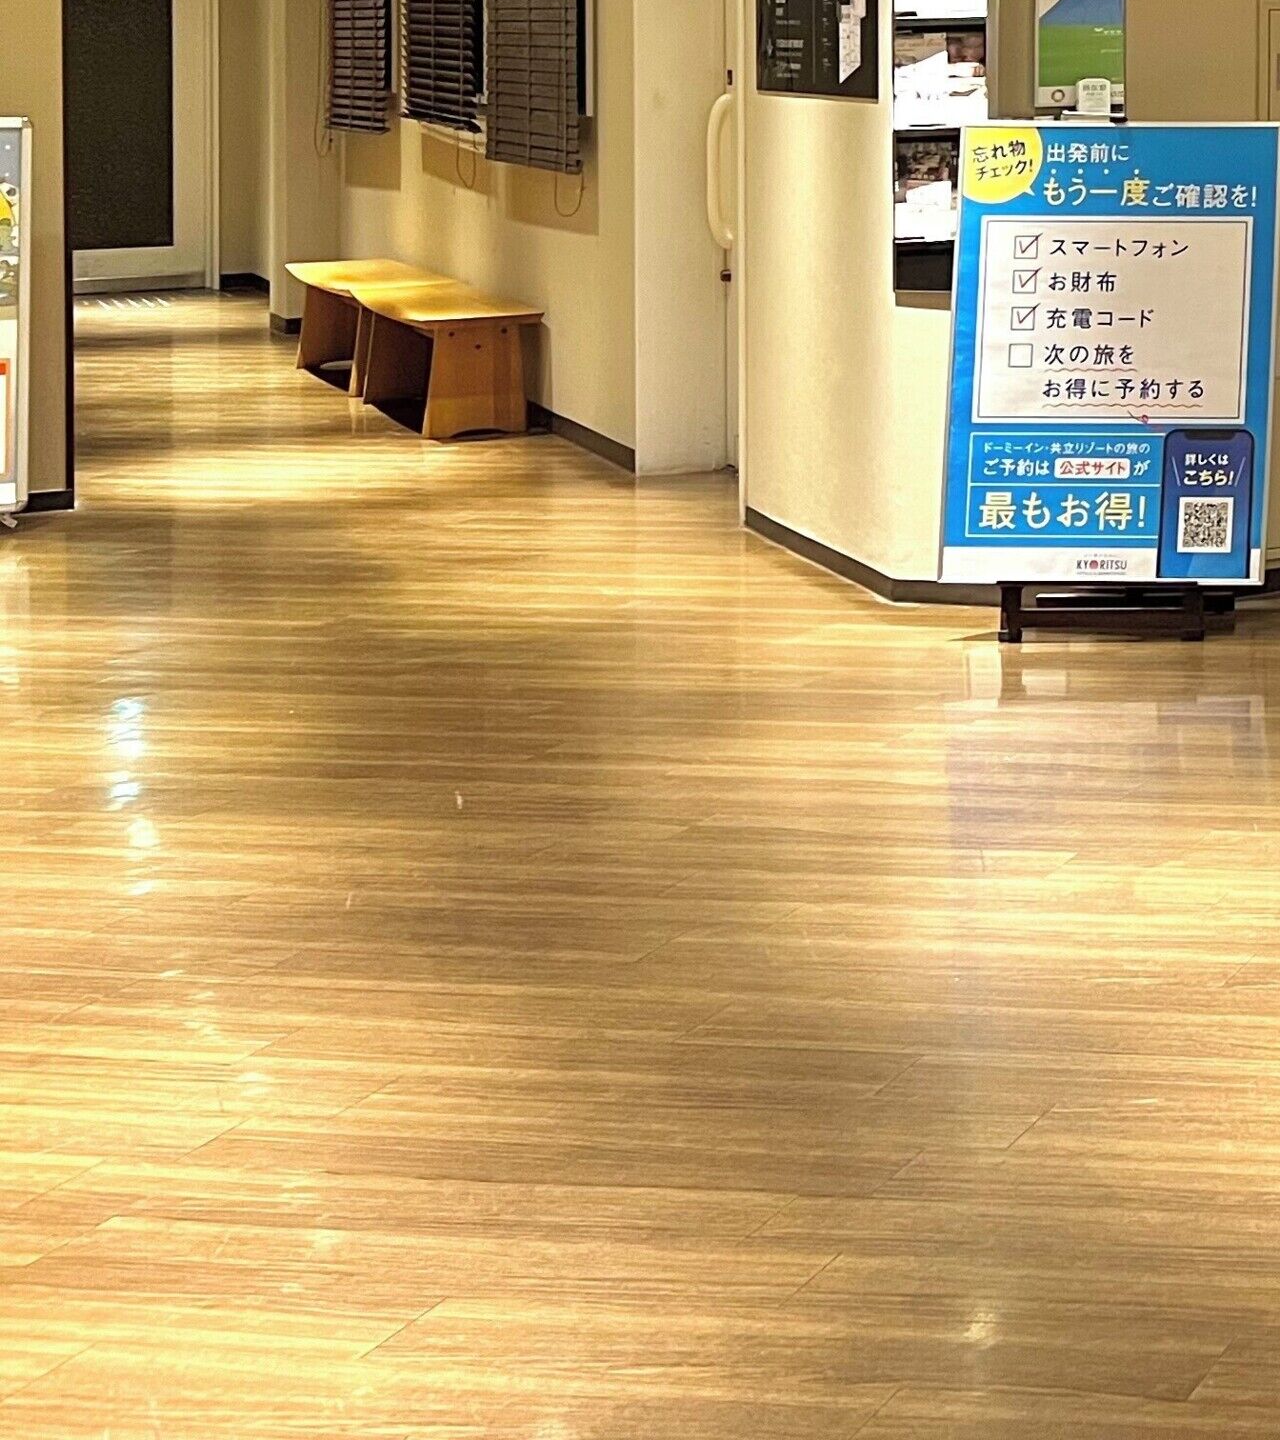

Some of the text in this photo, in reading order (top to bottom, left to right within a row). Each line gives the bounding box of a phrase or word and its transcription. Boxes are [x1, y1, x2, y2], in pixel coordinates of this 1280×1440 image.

[972, 140, 1026, 163] 忘れ物
[1046, 143, 1130, 163] 出発前に
[975, 159, 1034, 182] チェック!
[1050, 238, 1189, 258] スマートフォン
[1048, 271, 1117, 293] お財布
[1046, 307, 1154, 329] 充電コード
[1044, 344, 1134, 365] 次の旅を
[1042, 378, 1204, 399] お得に予約する
[984, 458, 1151, 477] ご予約は 公式サイト が
[1185, 453, 1228, 466] 詳しくは
[1183, 469, 1235, 487] こちら!
[978, 491, 1147, 531] 最もお得!
